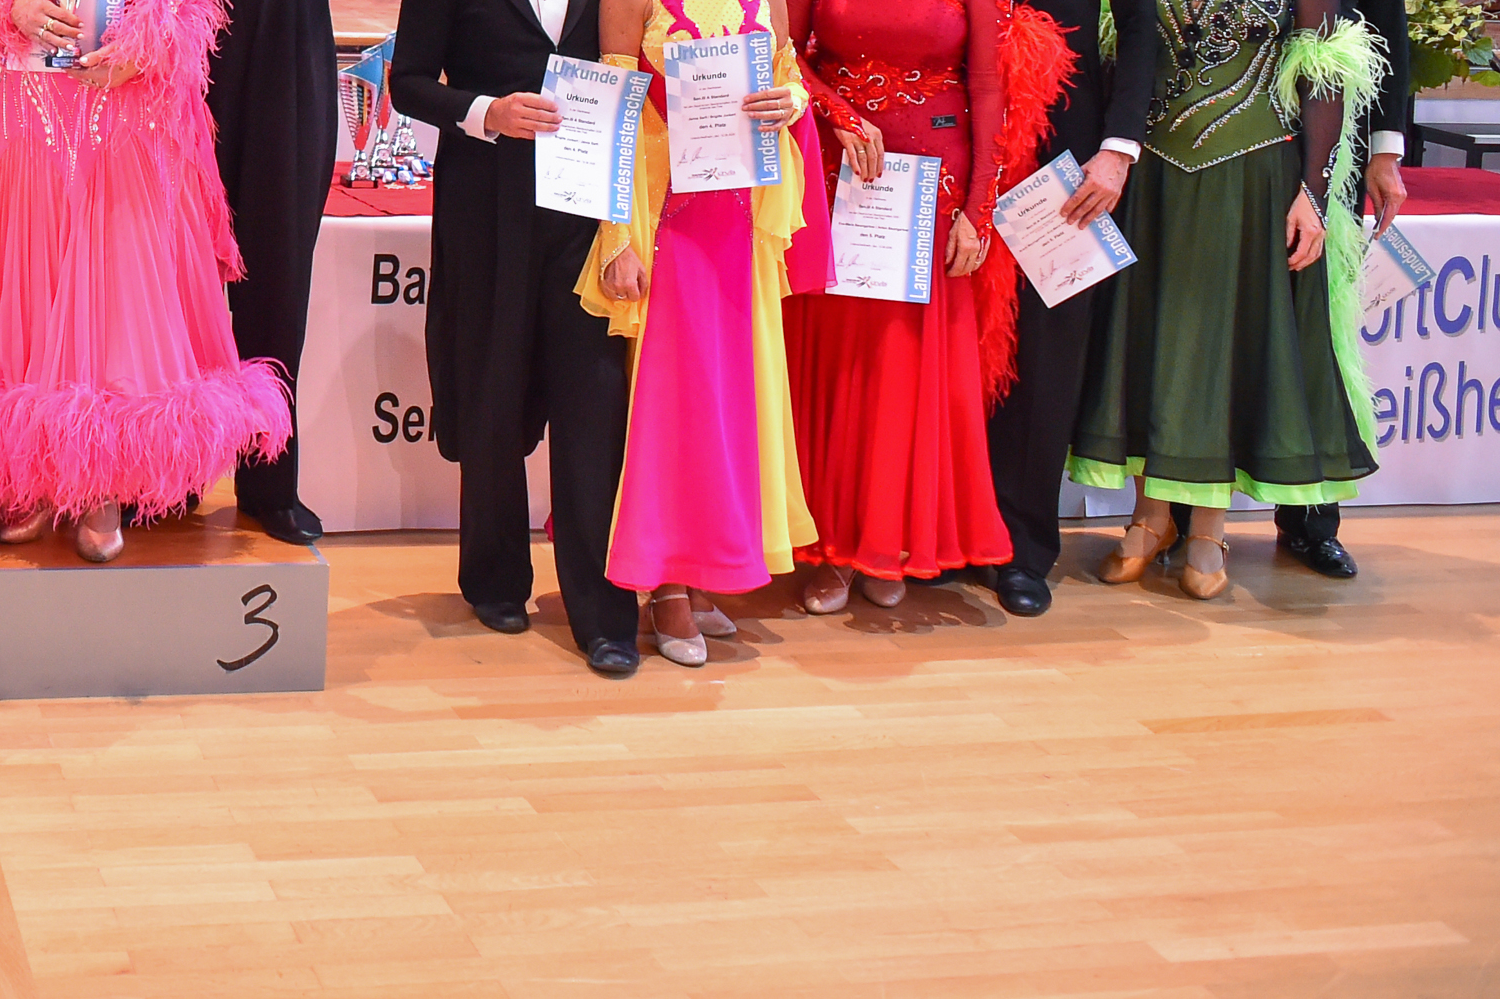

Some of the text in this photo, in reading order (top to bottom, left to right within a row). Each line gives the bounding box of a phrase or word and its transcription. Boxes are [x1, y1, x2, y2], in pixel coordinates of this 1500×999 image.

[670, 41, 739, 62] Urkunde
[553, 59, 619, 86] Urkunde
[692, 71, 727, 82] Urkunde
[566, 93, 599, 106] Urkunde
[612, 75, 649, 220] Landesmeisterschaft
[861, 182, 894, 193] Urkunde
[999, 174, 1050, 209] rkunde
[1017, 197, 1048, 217] Urkunde
[909, 161, 938, 299] Landesmeisterschaft
[1383, 225, 1432, 283] Landesmeis
[371, 253, 427, 305] Ba
[371, 391, 435, 444] Se
[216, 583, 281, 672] 3
